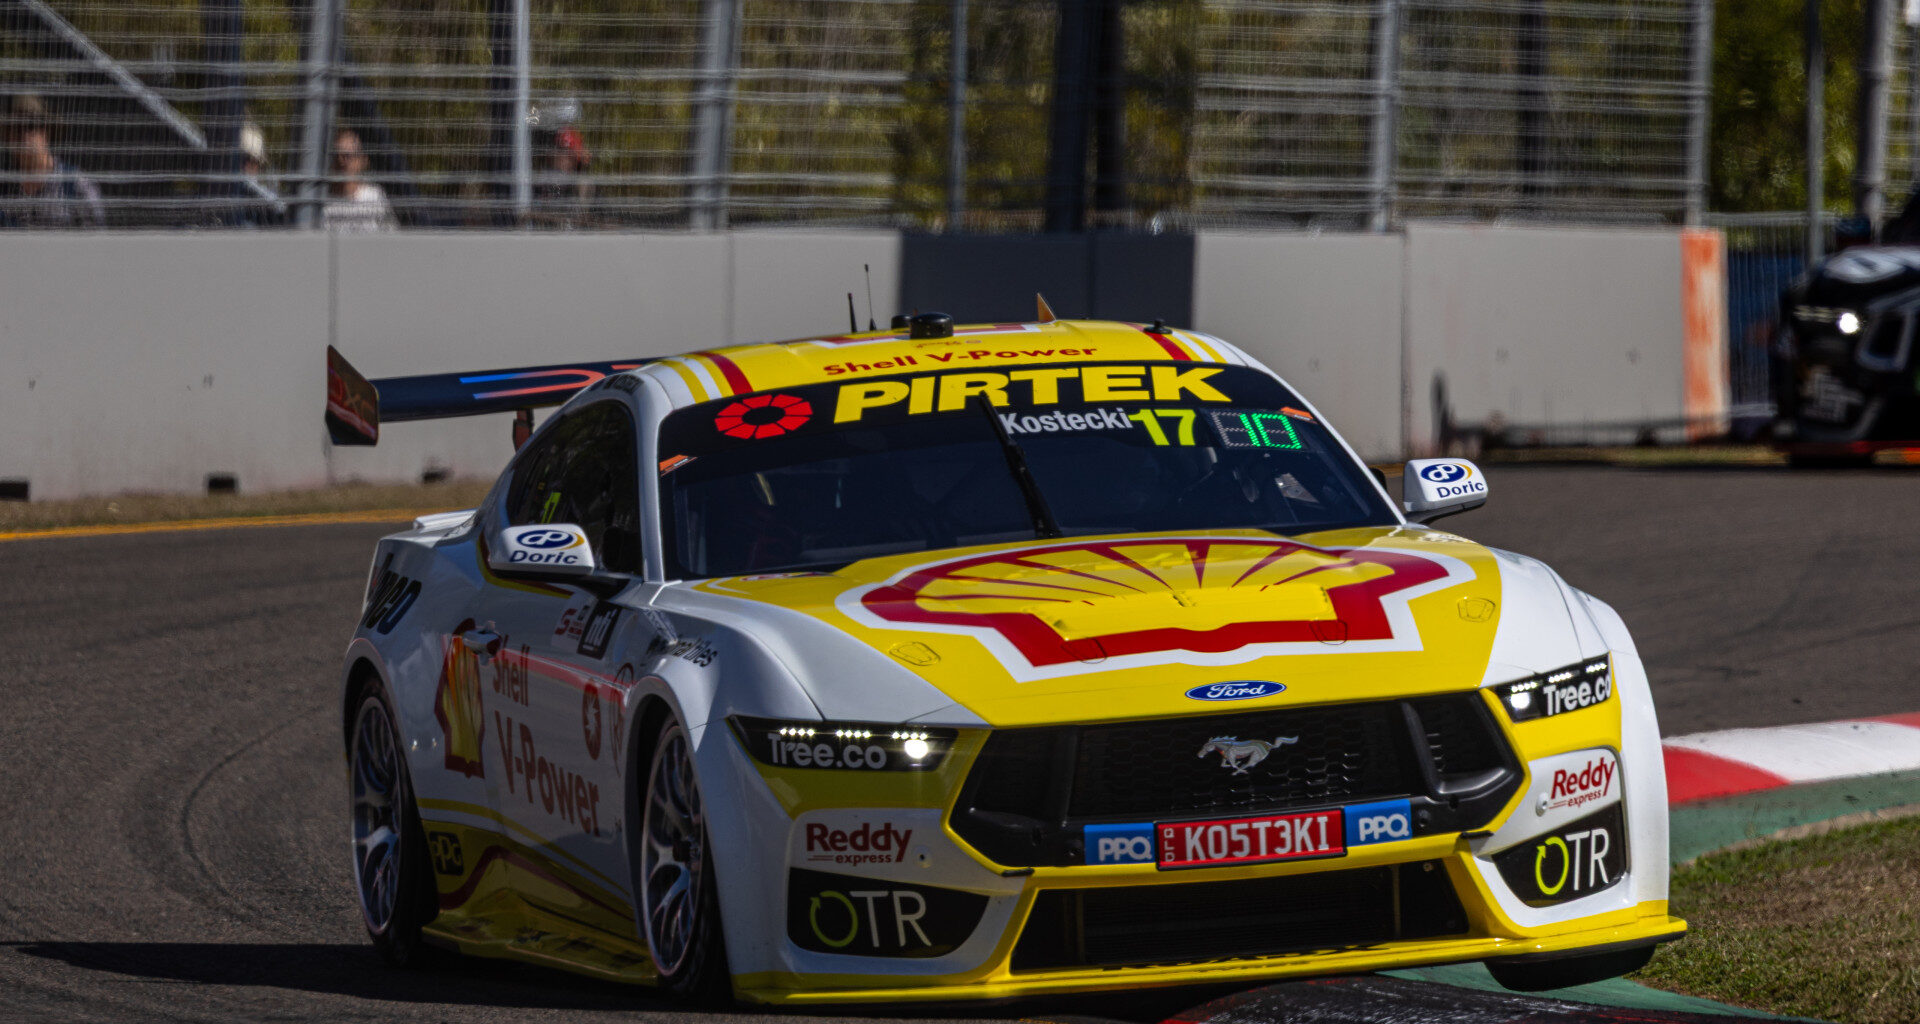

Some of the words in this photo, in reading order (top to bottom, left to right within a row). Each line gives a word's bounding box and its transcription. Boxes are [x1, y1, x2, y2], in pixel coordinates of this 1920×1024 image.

[823, 356, 918, 376] Shell
[927, 348, 1098, 363] V-Power
[833, 366, 1232, 424] PIRTEK
[1000, 407, 1134, 435] Kostecki
[1128, 409, 1196, 446] 17
[1436, 481, 1484, 498] Doric
[509, 550, 578, 564] Doric
[1206, 683, 1266, 698] Ford
[1543, 675, 1611, 716] Tree.co
[768, 733, 887, 769] Tree.co
[495, 710, 600, 838] V-Power
[1551, 757, 1615, 800] Reddy
[1568, 790, 1602, 808] express
[1359, 813, 1409, 842] PPQ
[806, 823, 912, 862] Reddy
[1098, 836, 1152, 861] PPQ
[835, 854, 892, 866] express
